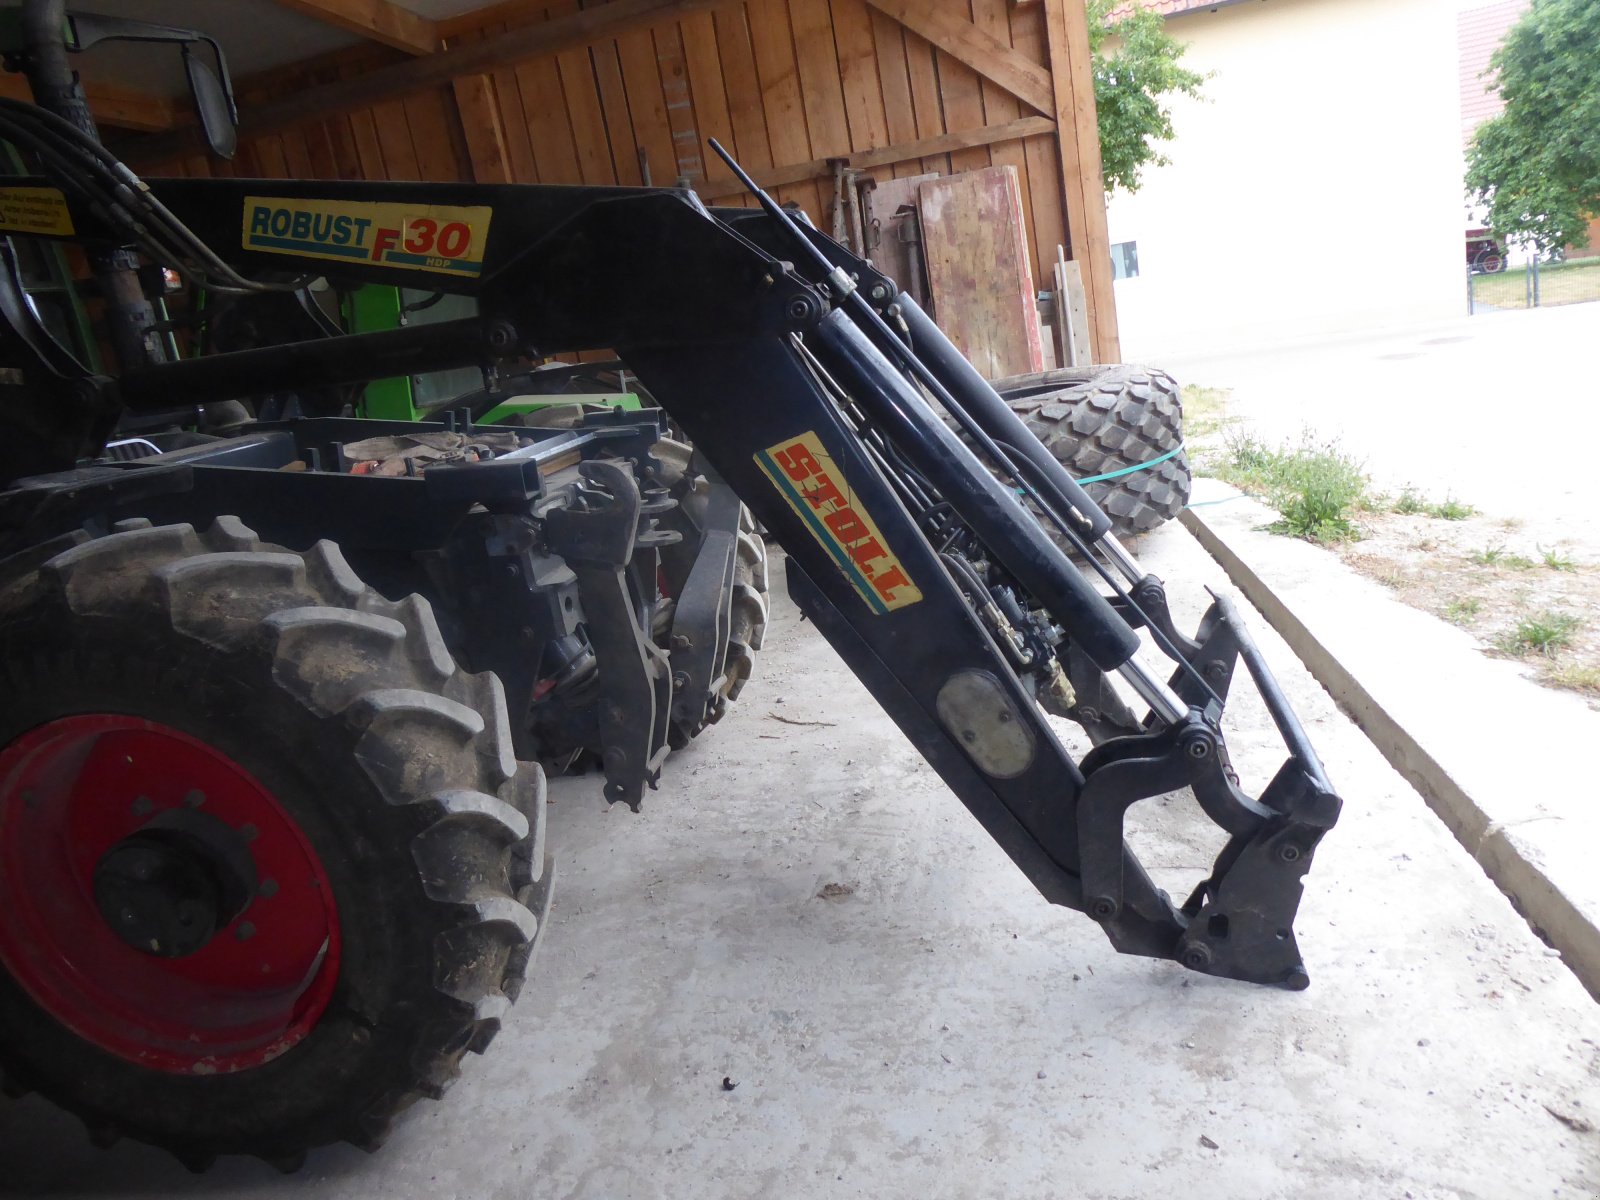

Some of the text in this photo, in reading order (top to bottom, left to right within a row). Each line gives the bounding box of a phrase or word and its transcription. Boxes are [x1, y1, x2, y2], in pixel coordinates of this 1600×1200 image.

[251, 206, 372, 246] ROBUST
[425, 257, 452, 269] HDP
[774, 442, 911, 603] STOLL
